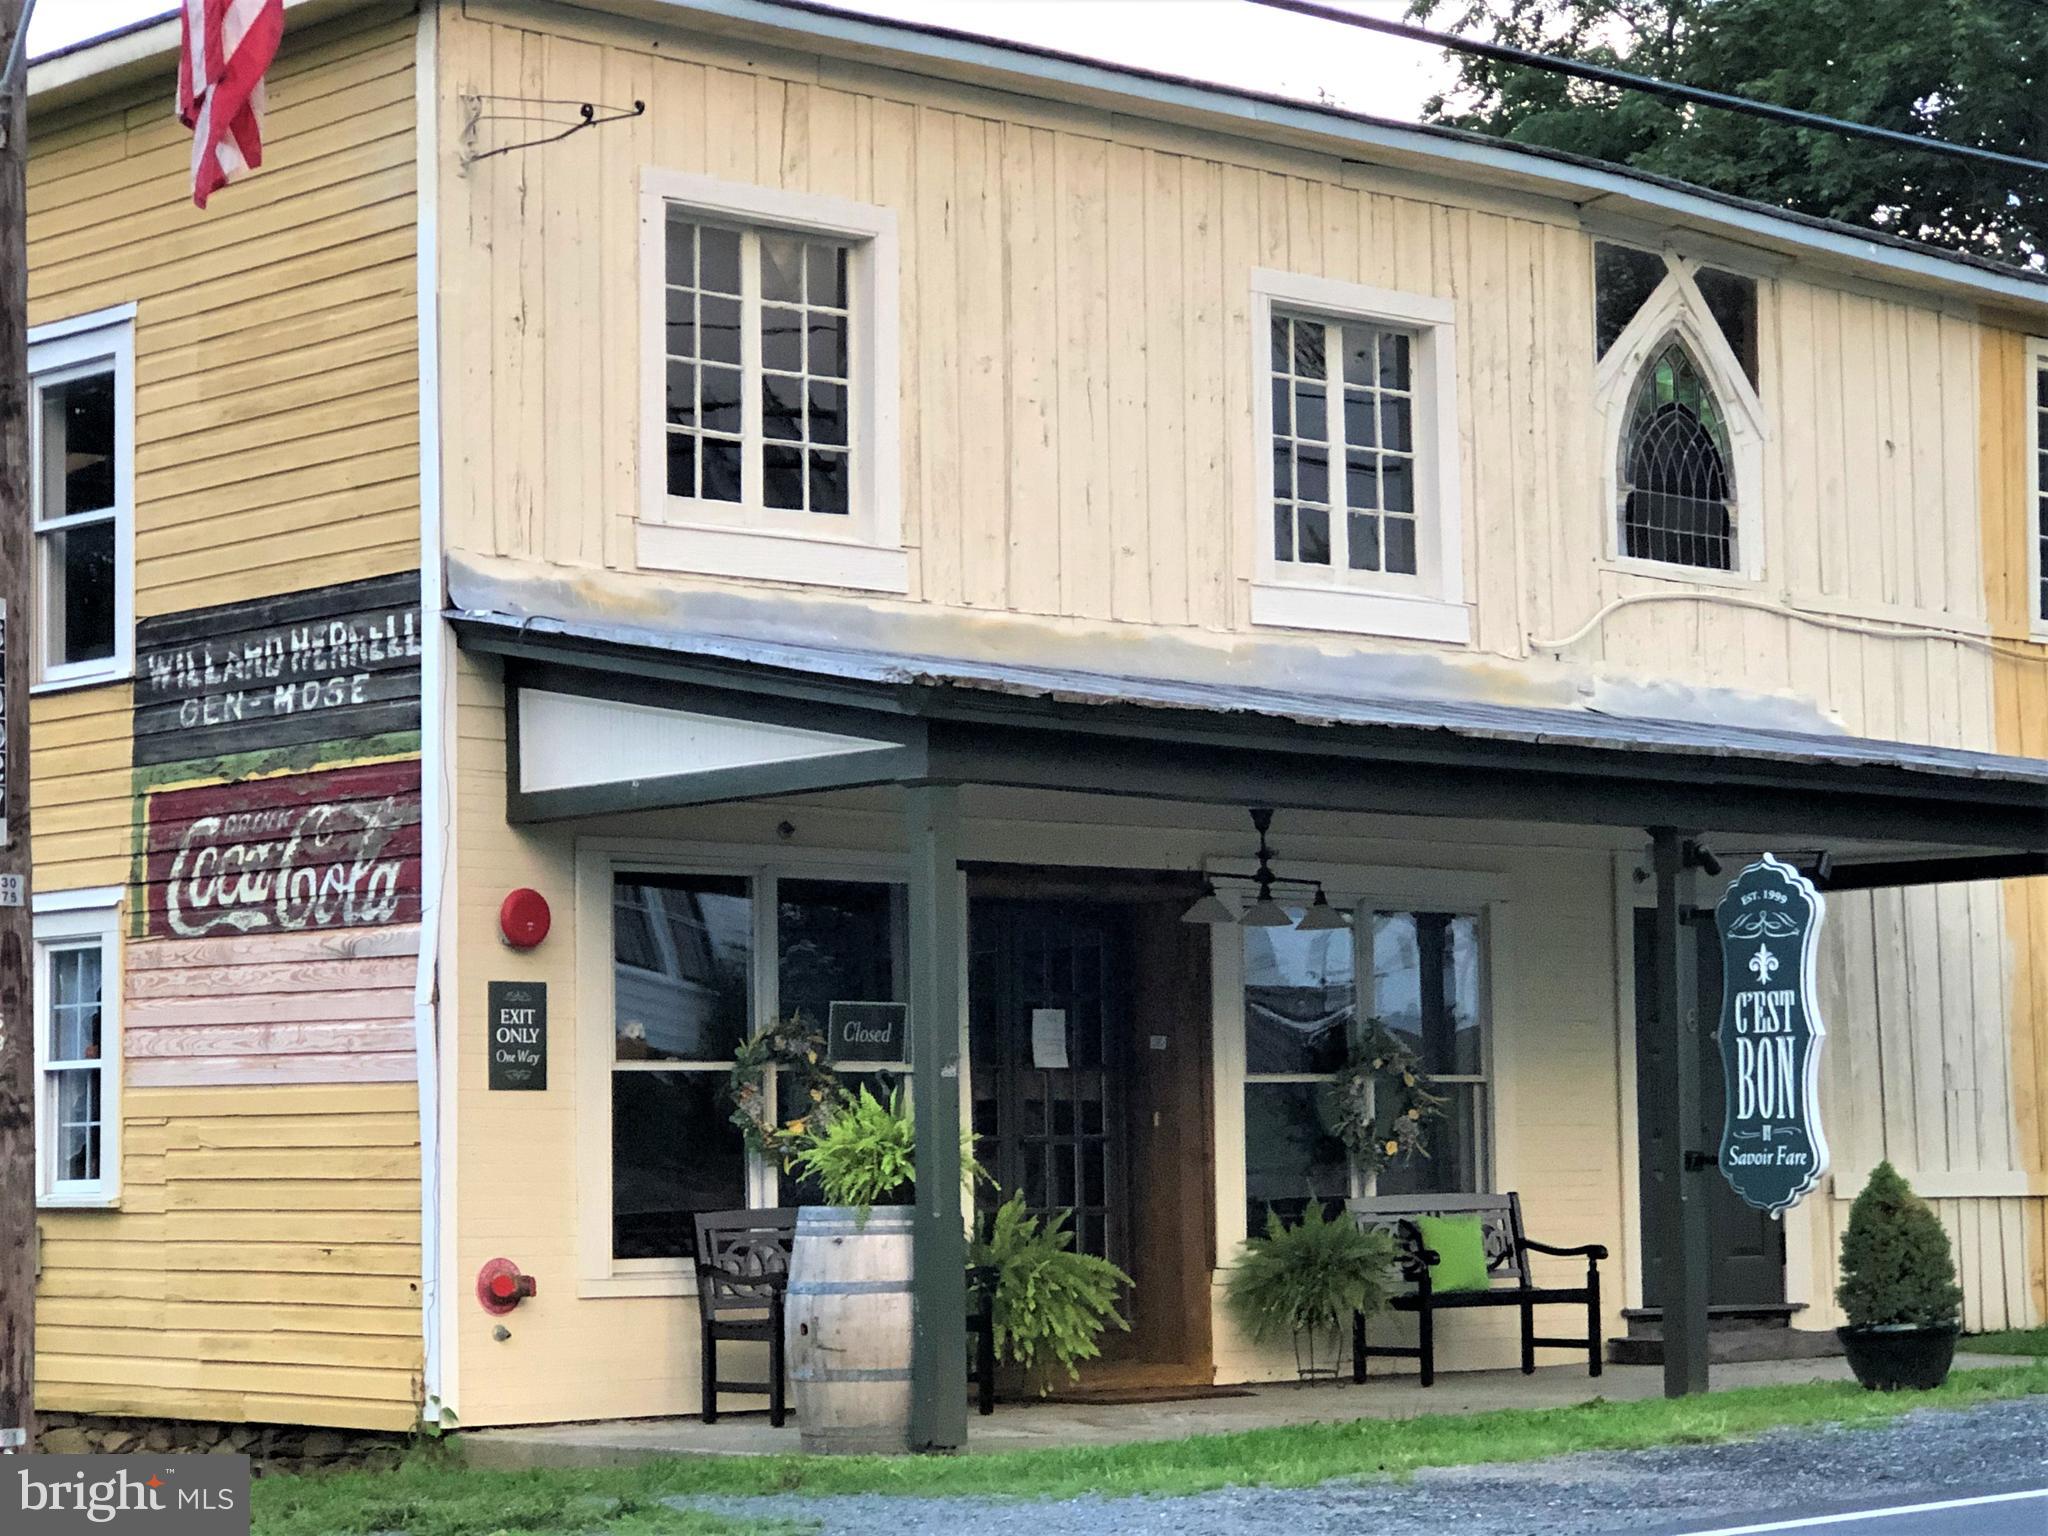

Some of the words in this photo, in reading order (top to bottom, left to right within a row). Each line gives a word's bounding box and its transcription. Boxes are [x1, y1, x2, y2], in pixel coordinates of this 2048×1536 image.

[500, 1008, 536, 1025] EXIT
[1735, 989, 1796, 1034] C'EST
[496, 1027, 540, 1043] ONLY
[843, 1021, 892, 1043] Closed
[496, 1049, 515, 1063] One
[517, 1049, 540, 1066] Way
[1736, 1035, 1796, 1120] BON
[1729, 1145, 1774, 1166] Savoir
[1776, 1145, 1808, 1166] Fare
